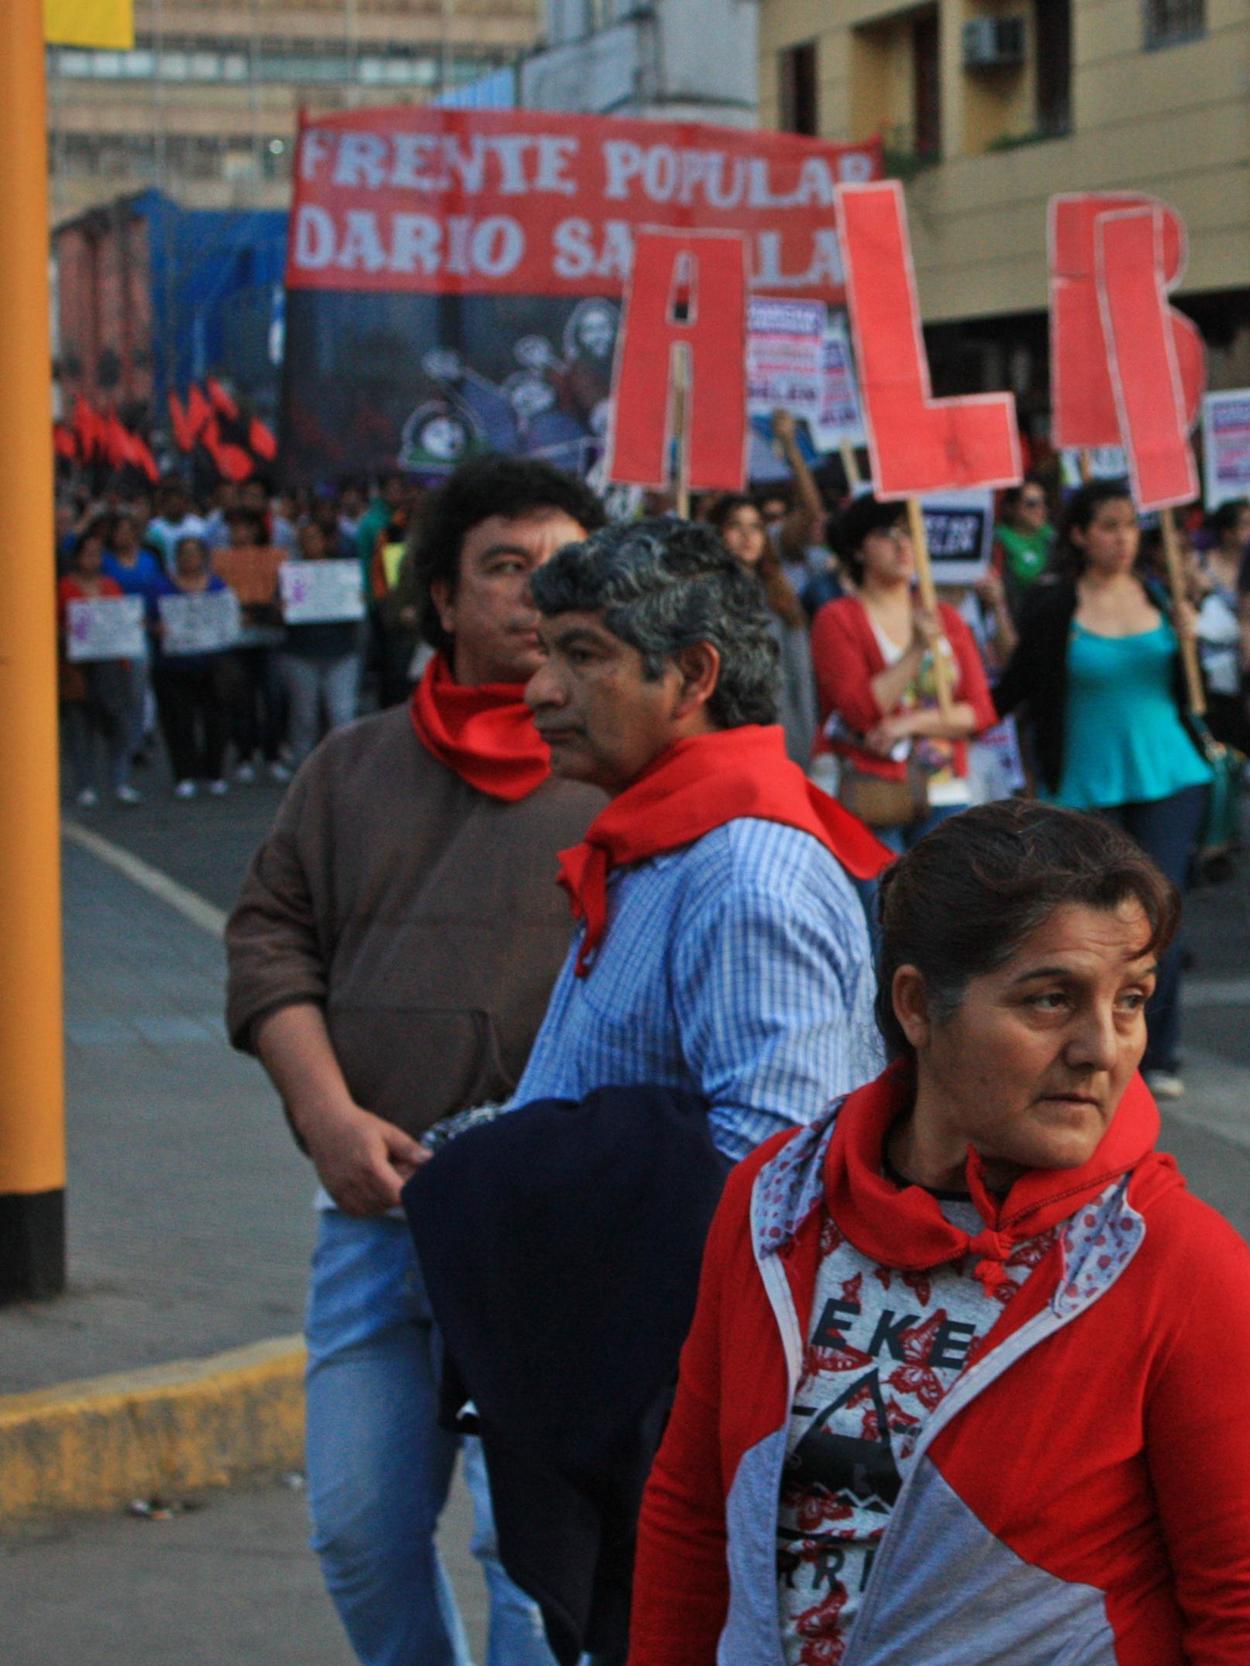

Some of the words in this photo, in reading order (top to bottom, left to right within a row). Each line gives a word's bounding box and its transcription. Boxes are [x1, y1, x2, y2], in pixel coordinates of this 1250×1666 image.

[302, 128, 580, 196] FRENTE
[603, 139, 874, 208] POPULAR
[294, 204, 524, 278] DARIO
